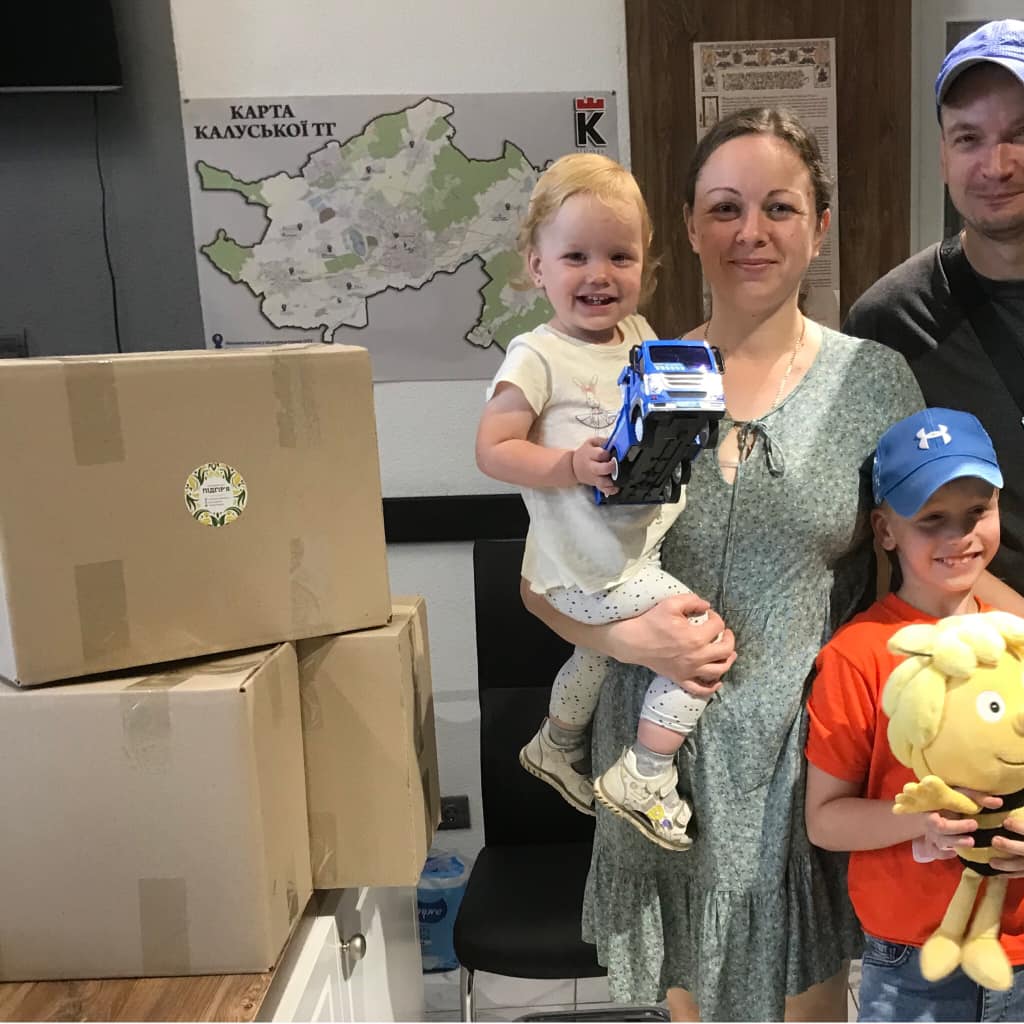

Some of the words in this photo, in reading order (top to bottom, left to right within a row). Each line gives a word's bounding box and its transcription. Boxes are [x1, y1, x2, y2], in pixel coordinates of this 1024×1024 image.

[229, 104, 296, 120] КАРТА
[193, 120, 309, 140] КАЛУСЬКОЇ
[311, 122, 337, 137] ТГ
